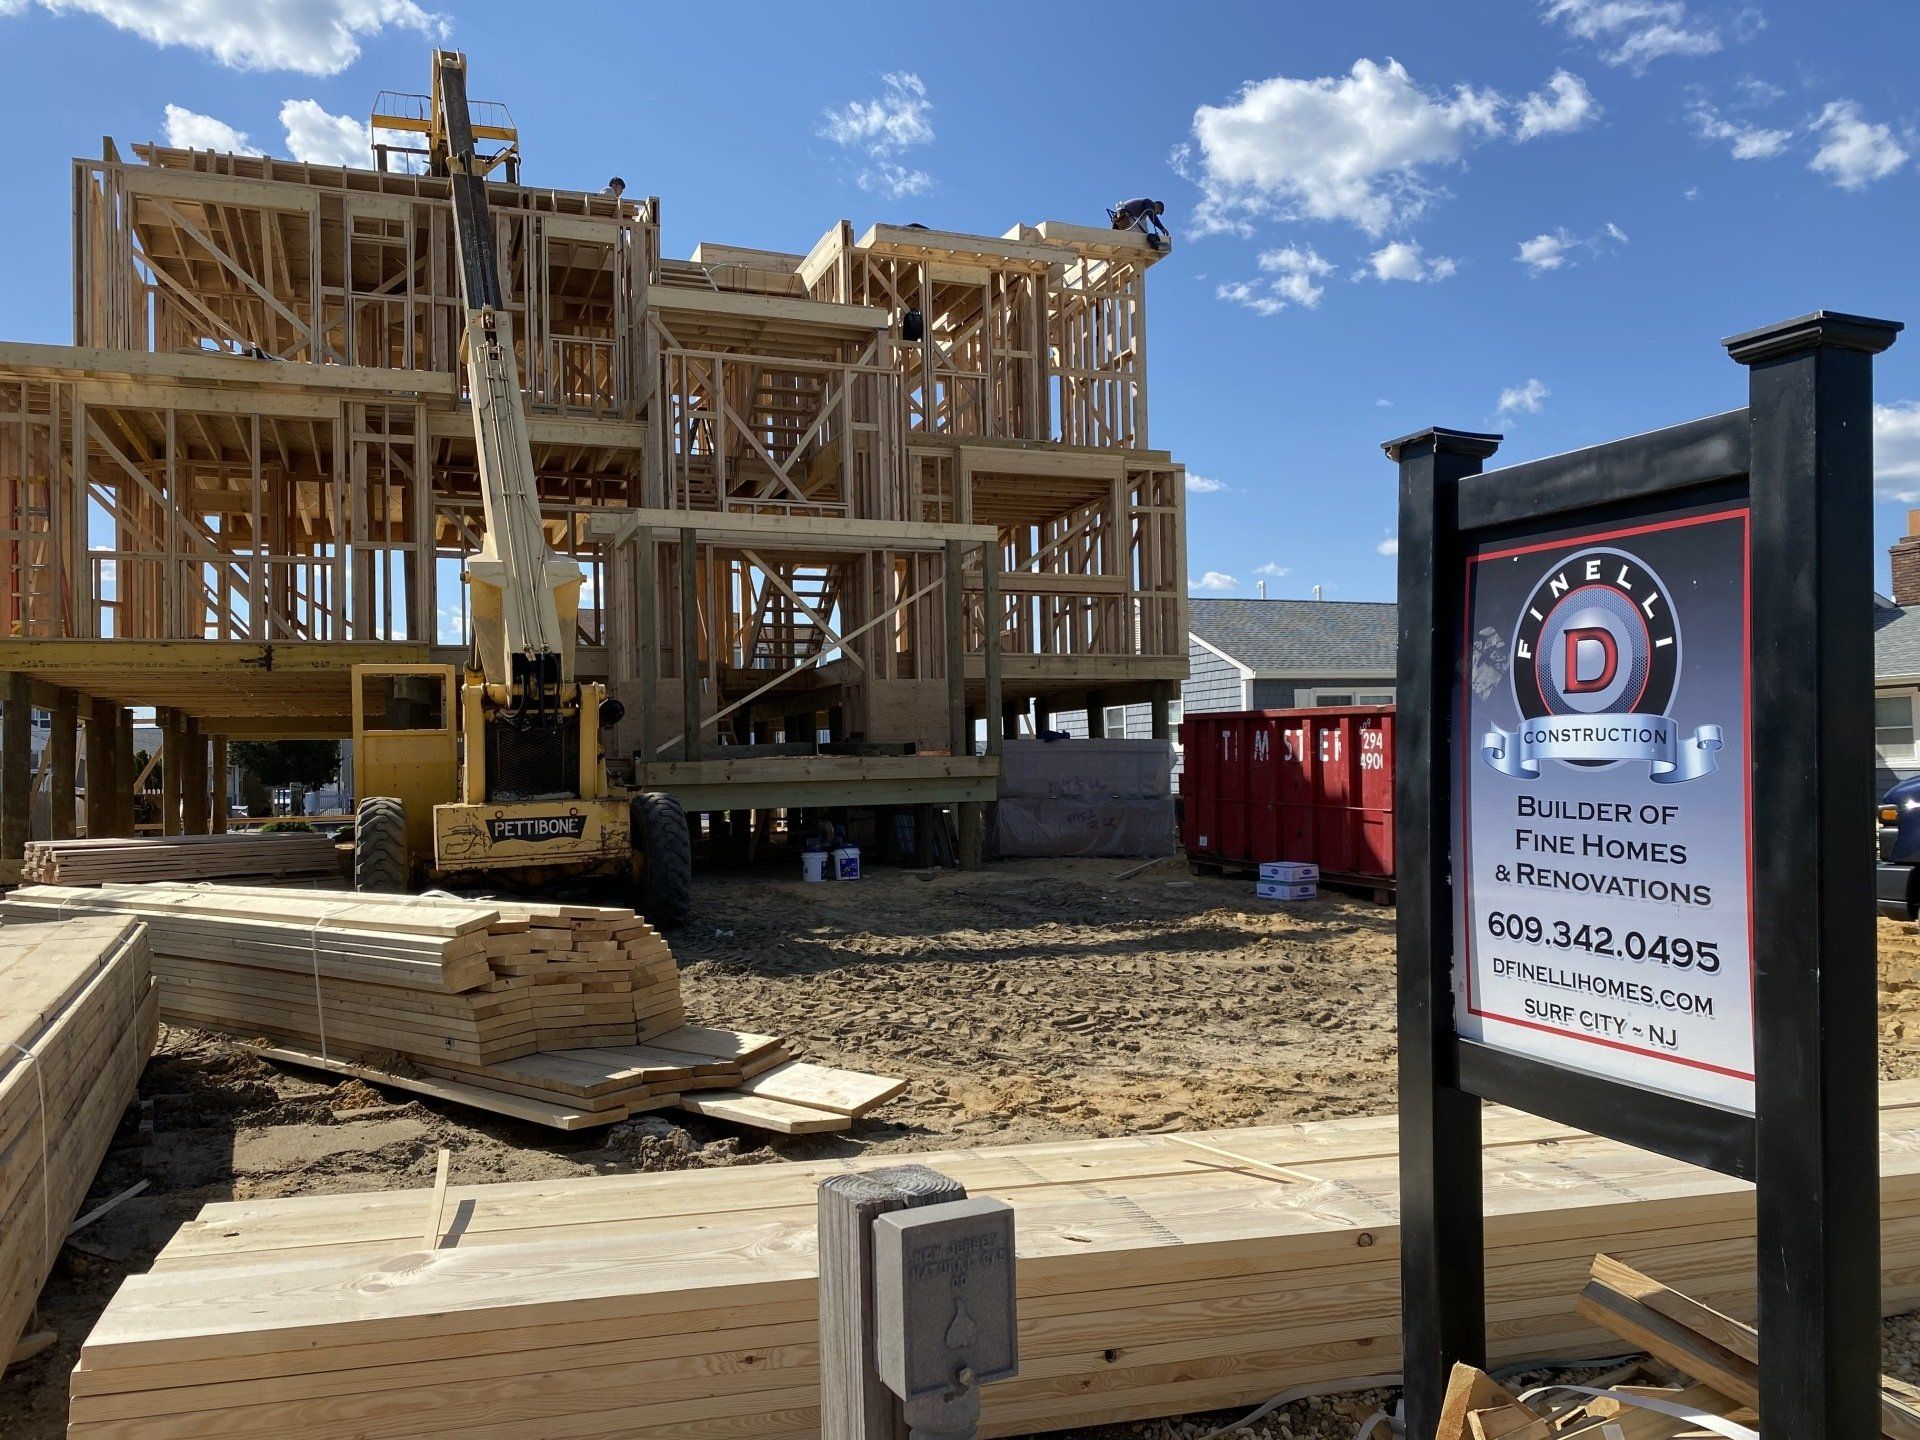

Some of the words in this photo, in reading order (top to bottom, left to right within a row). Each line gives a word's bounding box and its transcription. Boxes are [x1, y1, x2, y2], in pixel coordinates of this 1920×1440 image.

[1517, 559, 1673, 660] FINELLI
[1562, 626, 1619, 694] D
[1363, 732, 1383, 750] 294
[1523, 728, 1668, 745] CONSTRUCTION
[494, 818, 579, 838] PETTIBONE
[1517, 795, 1633, 824] BUILDER
[1639, 804, 1679, 826] OF
[1515, 829, 1575, 856] FINE
[1582, 833, 1688, 865] HOMES
[1495, 864, 1512, 883] &
[1516, 862, 1713, 906] RENOVATIONS
[1487, 911, 1721, 974] 609.342.0495
[1493, 957, 1714, 1017] DFINELLIHOMES.COM
[1524, 998, 1575, 1023] SURF
[1579, 1009, 1626, 1035] CITY
[1649, 1024, 1678, 1047] NJ
